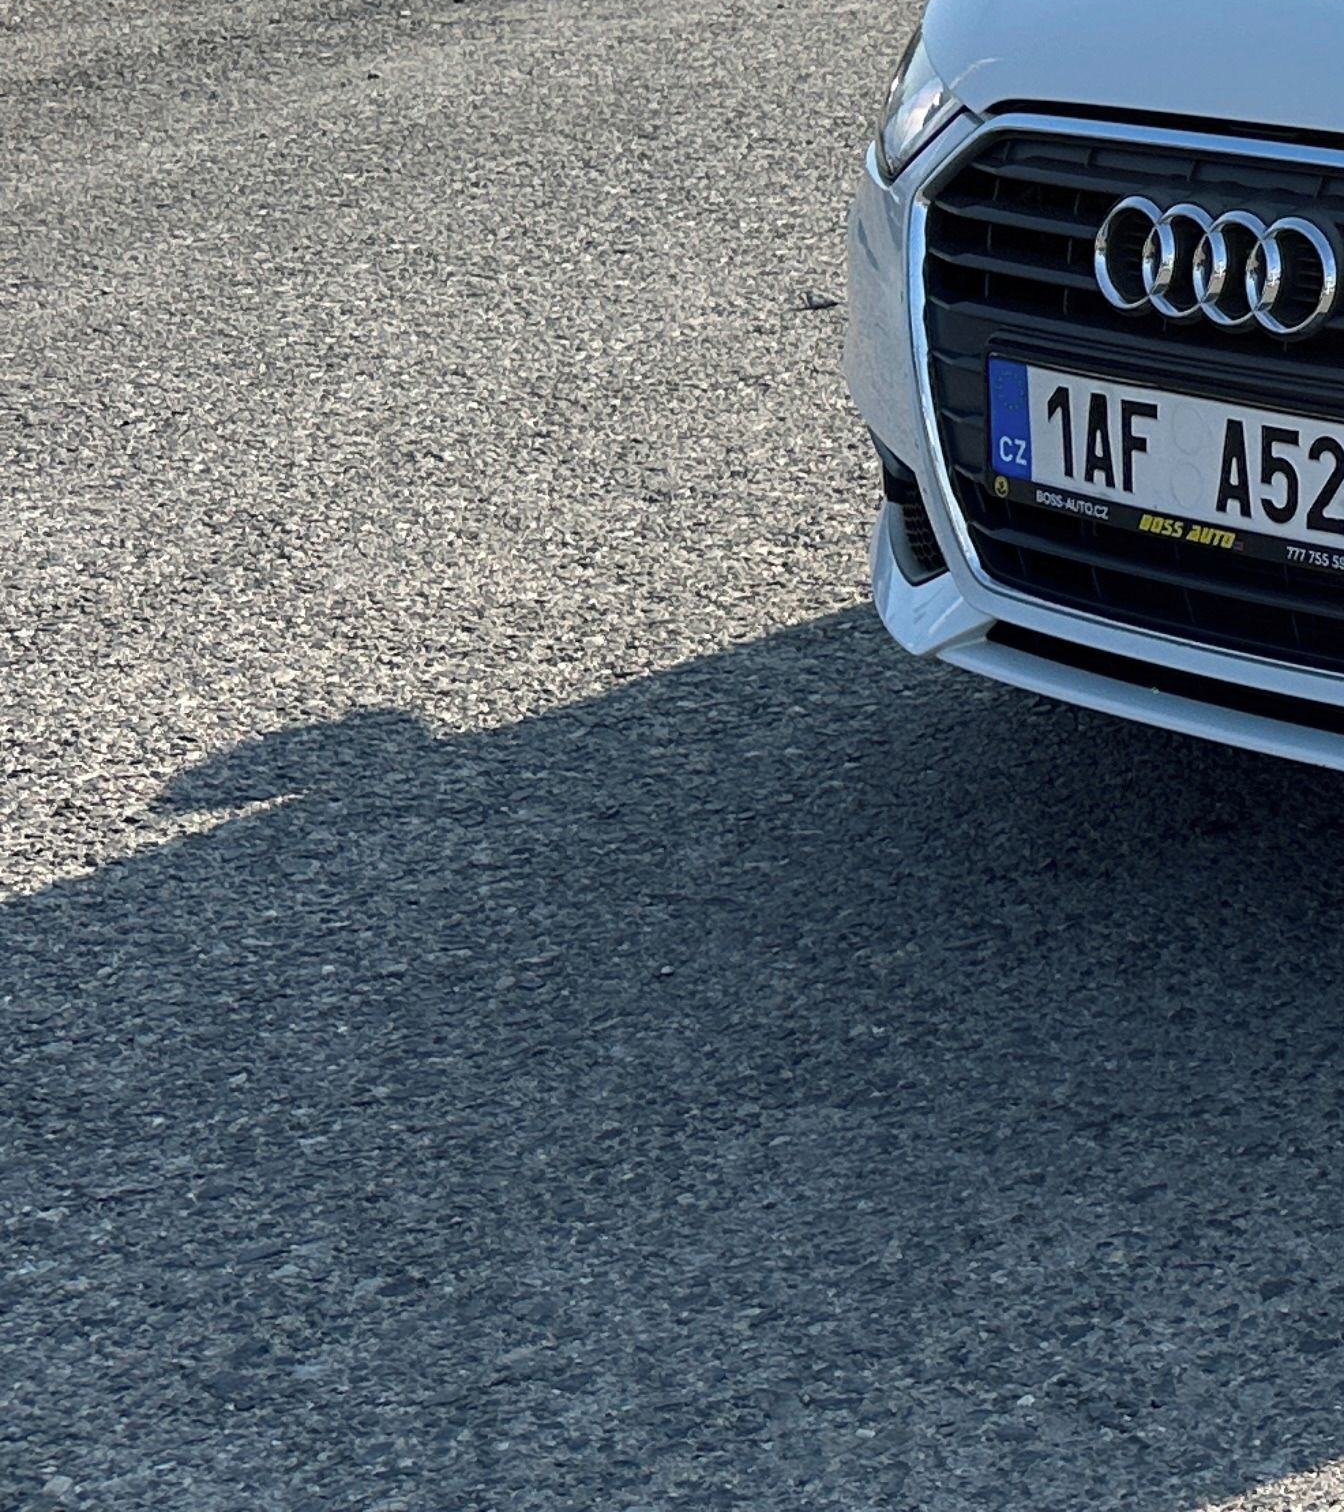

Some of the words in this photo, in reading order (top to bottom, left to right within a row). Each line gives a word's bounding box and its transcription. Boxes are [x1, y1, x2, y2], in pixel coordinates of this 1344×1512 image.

[1000, 435, 1027, 466] CZ
[1047, 386, 1158, 494] 1AF
[1036, 490, 1109, 520] BOSS-AUTO.CZ
[1286, 546, 1306, 562] 777
[1308, 550, 1330, 567] 755
